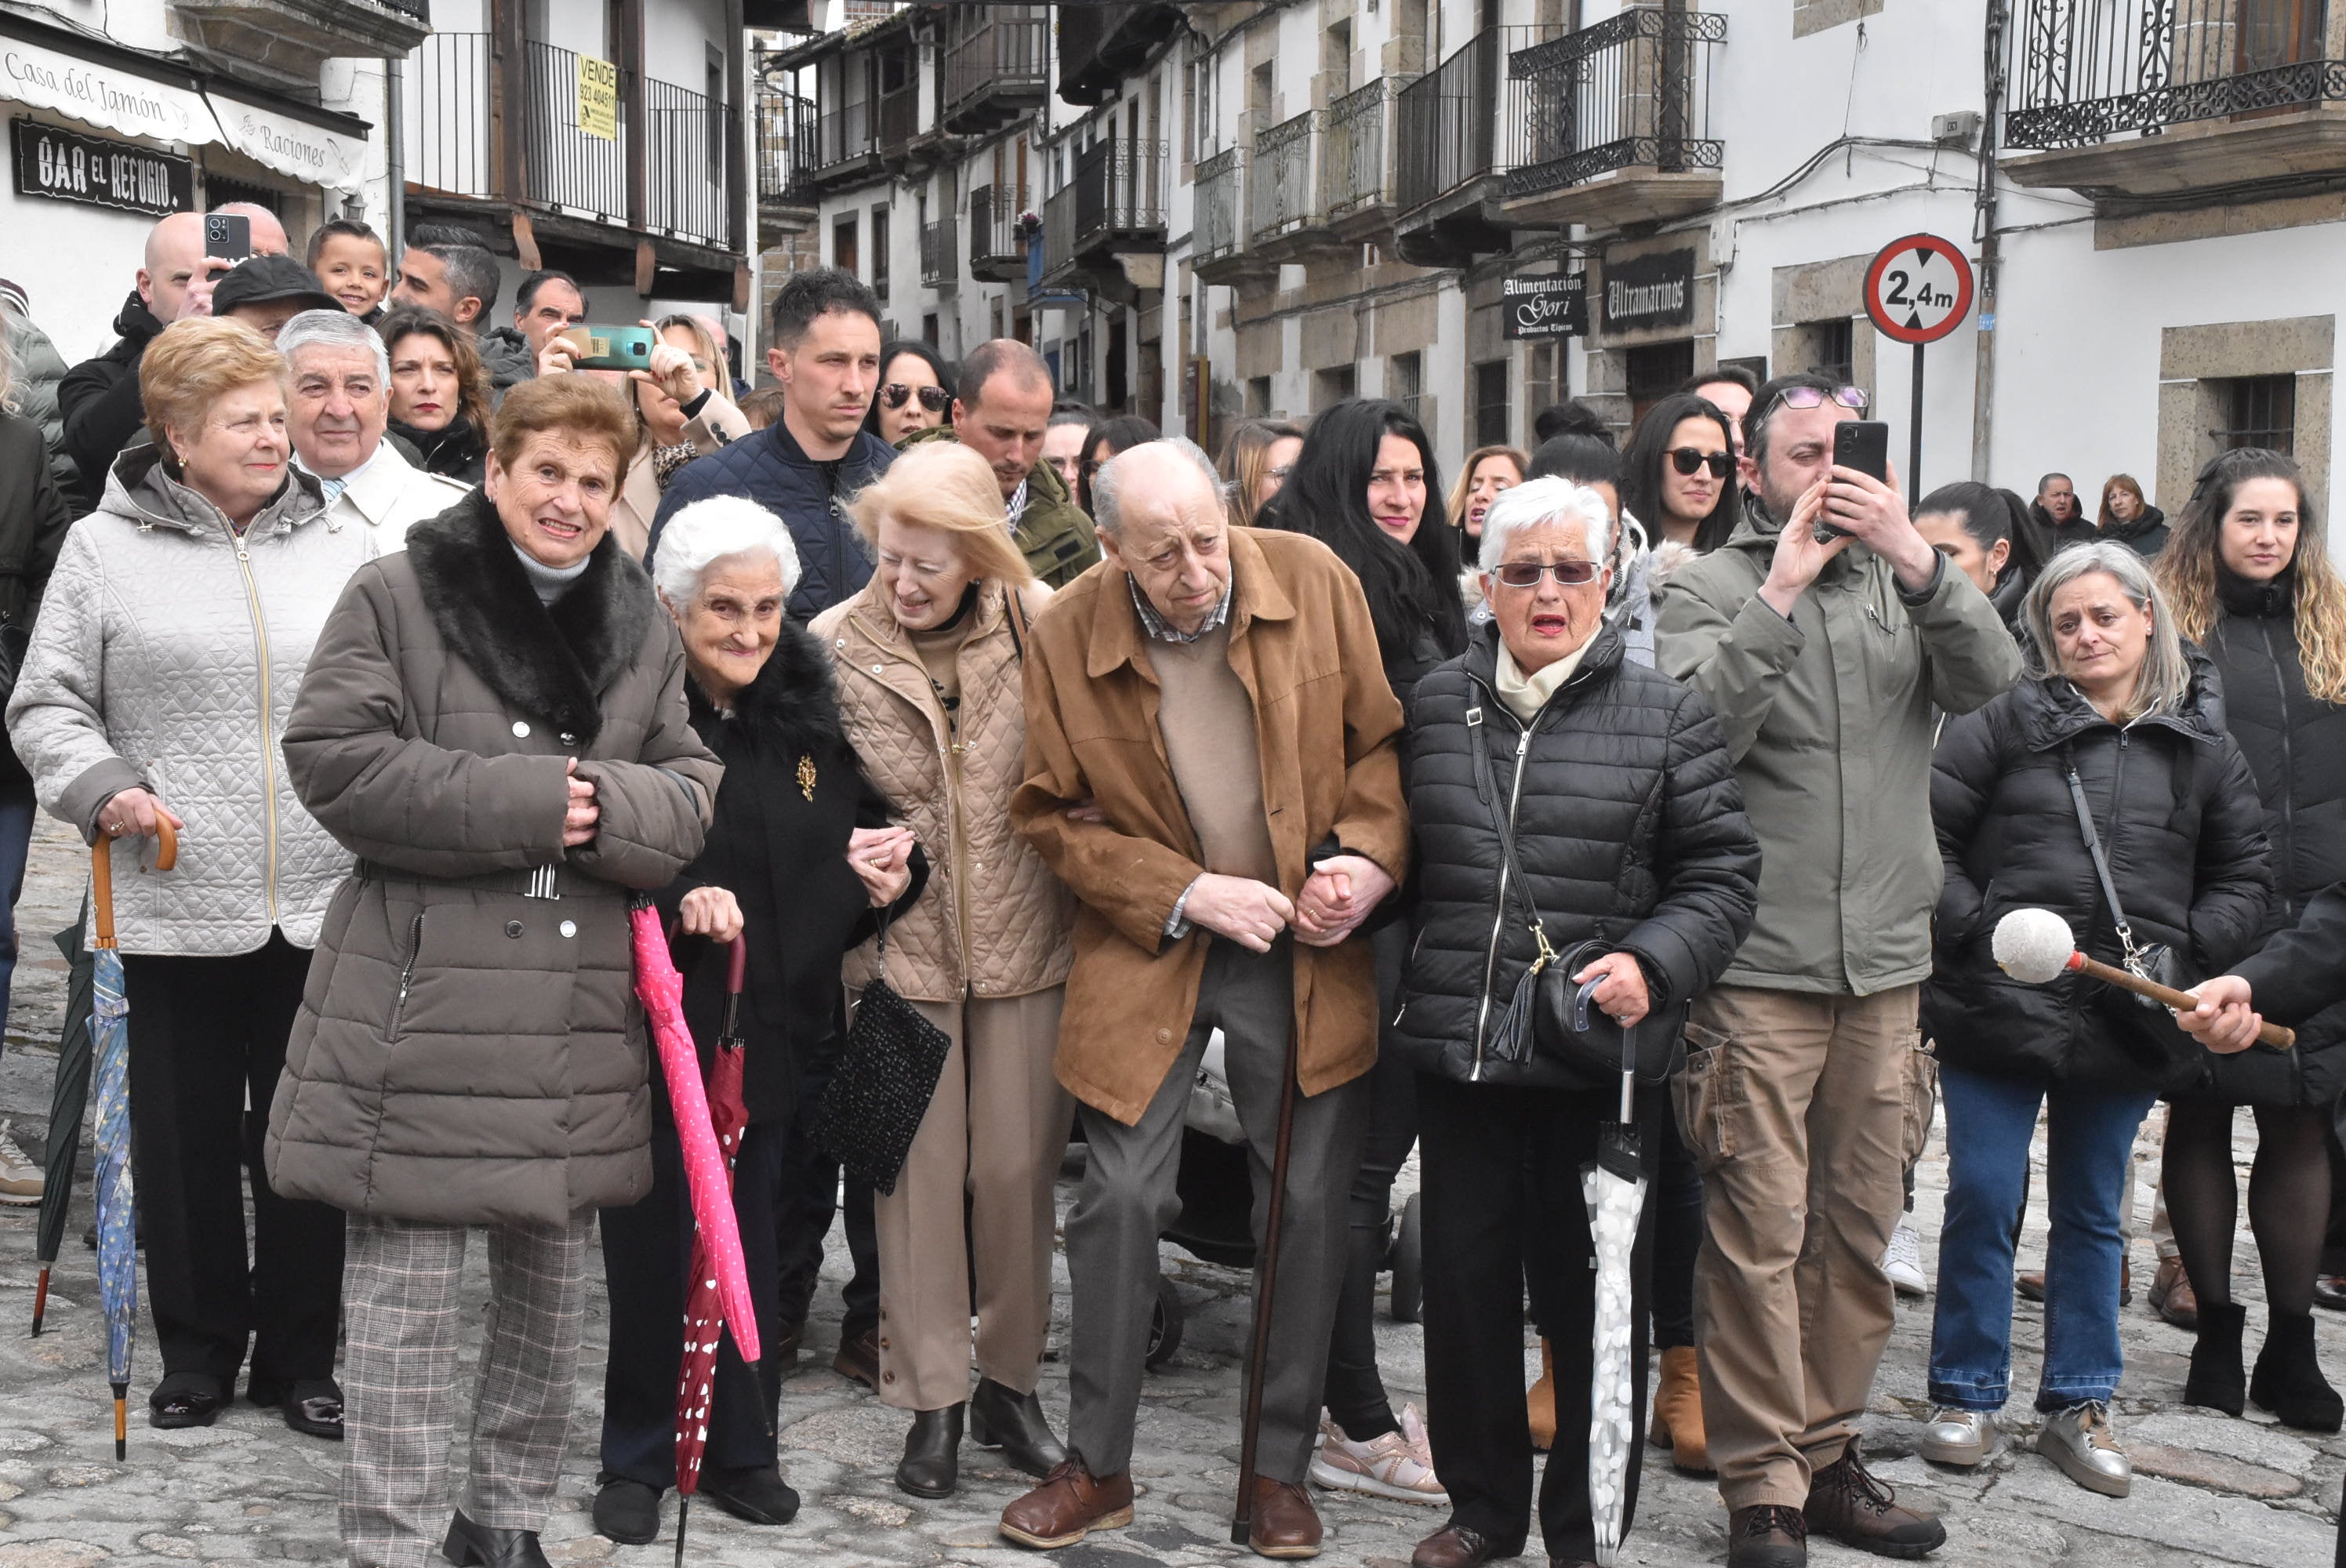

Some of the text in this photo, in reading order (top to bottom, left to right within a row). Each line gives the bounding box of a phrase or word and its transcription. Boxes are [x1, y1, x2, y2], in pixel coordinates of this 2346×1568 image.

[5, 53, 166, 122] Casa del Jamón
[580, 56, 614, 88] VENDE
[580, 83, 591, 102] 923
[260, 125, 325, 168] Raciones
[38, 136, 87, 194] BAR
[91, 155, 107, 184] EL
[1504, 274, 1582, 296] Alimentación
[1608, 273, 1685, 320] Ultramarinos
[1516, 294, 1571, 326] Gori
[1517, 325, 1549, 335] Productos
